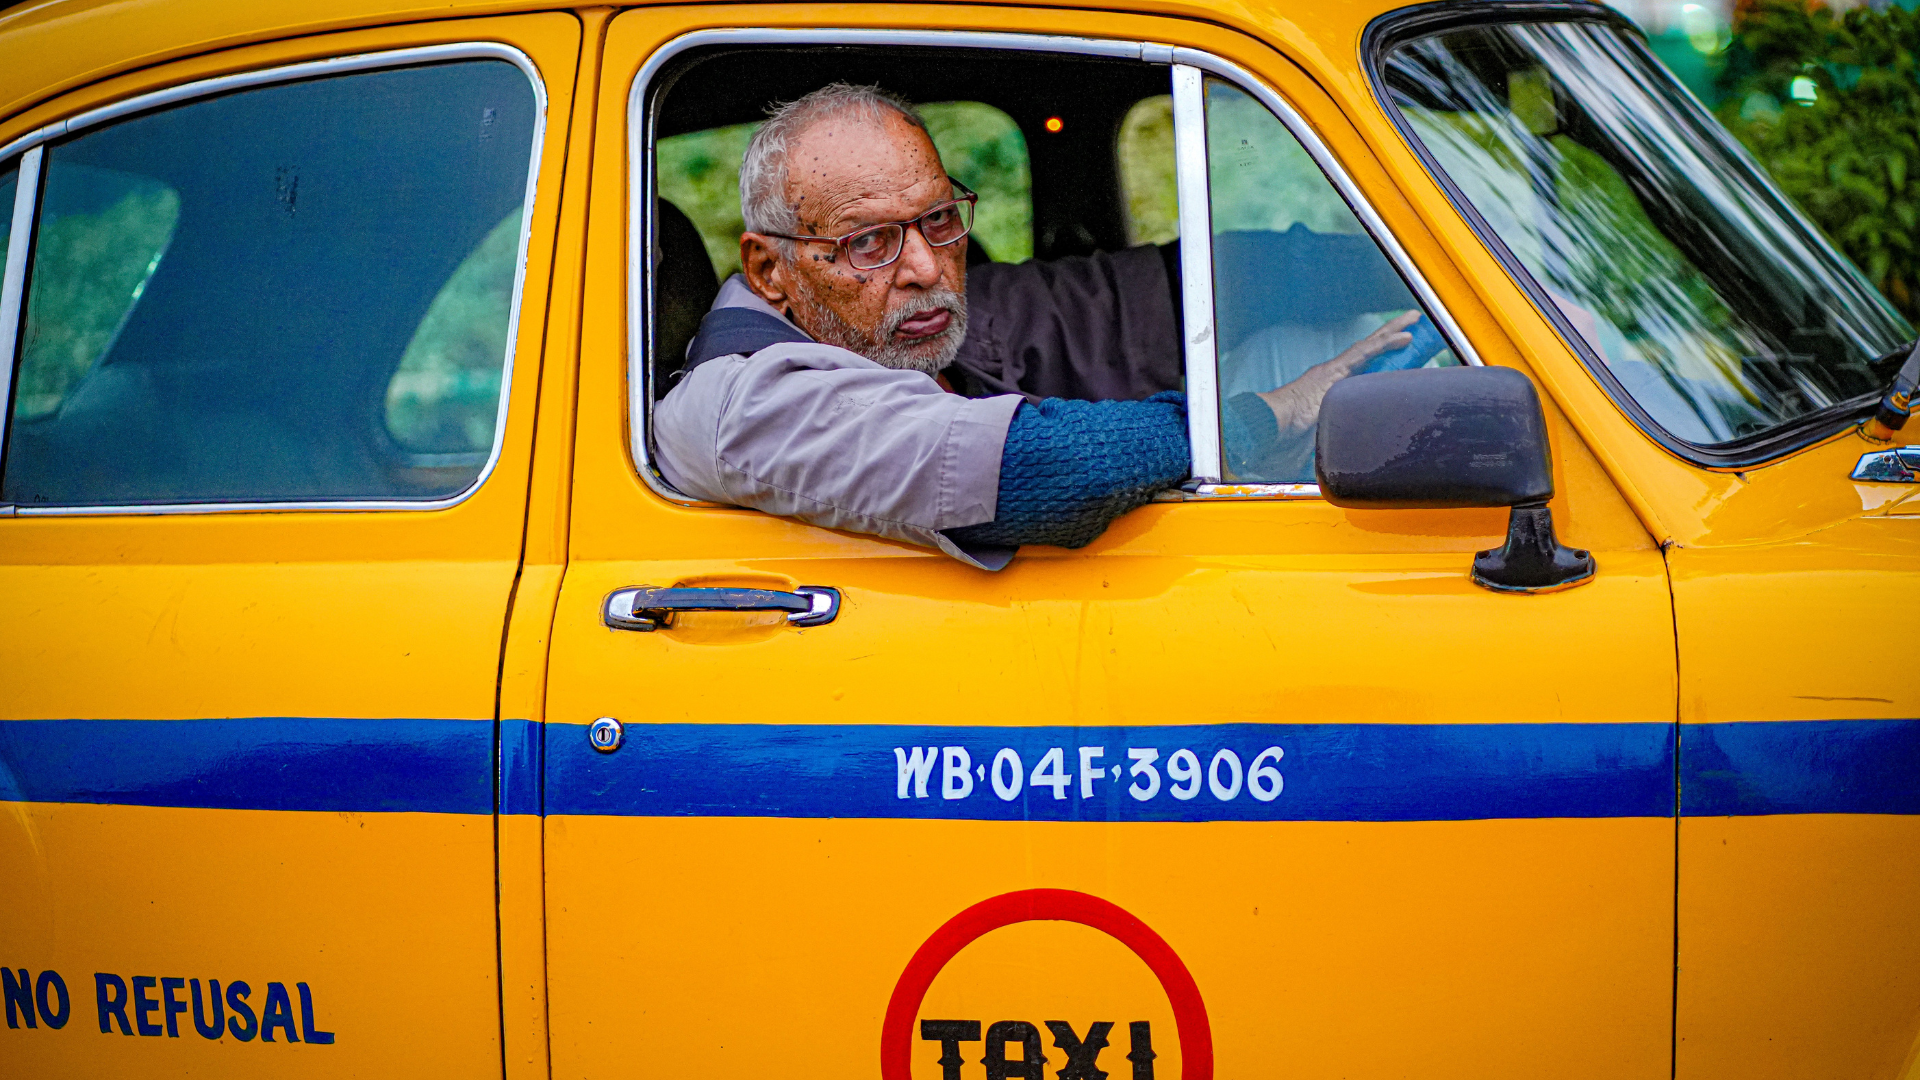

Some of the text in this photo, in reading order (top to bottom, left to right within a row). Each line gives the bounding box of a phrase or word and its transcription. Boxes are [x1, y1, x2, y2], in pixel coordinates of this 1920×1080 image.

[0, 967, 335, 1044] NO REFUSAL
[920, 1019, 1158, 1080] TAXI
